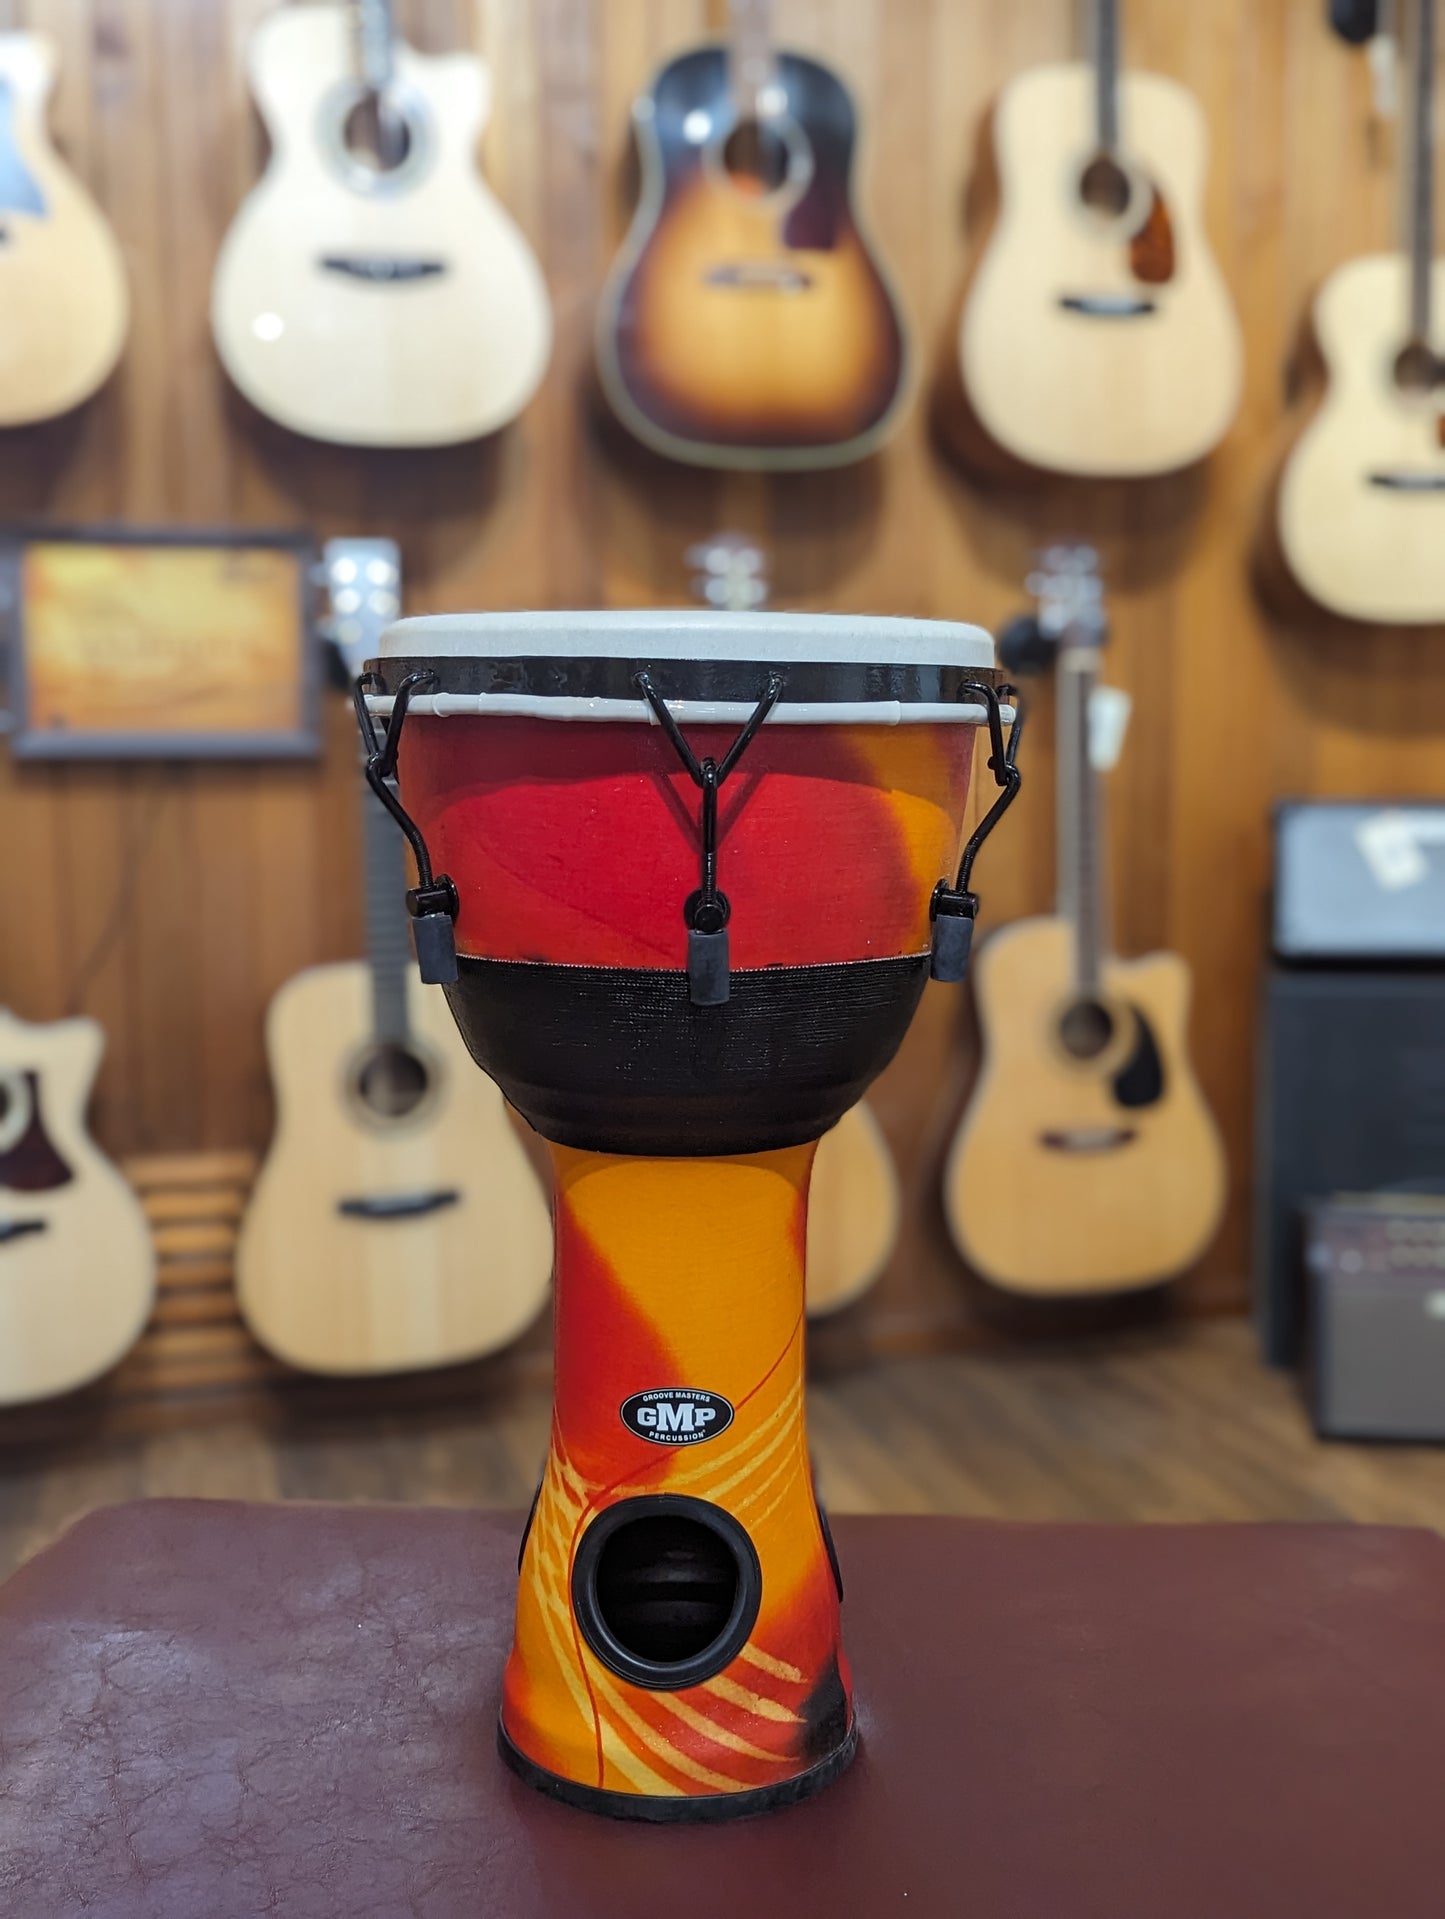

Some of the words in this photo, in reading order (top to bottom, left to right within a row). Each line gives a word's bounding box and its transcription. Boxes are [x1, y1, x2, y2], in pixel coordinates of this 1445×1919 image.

[643, 1392, 674, 1402] GROOVE
[675, 1392, 711, 1402] MASTERS
[637, 1403, 716, 1431] GMP
[649, 1431, 704, 1441] PERCUSSION
